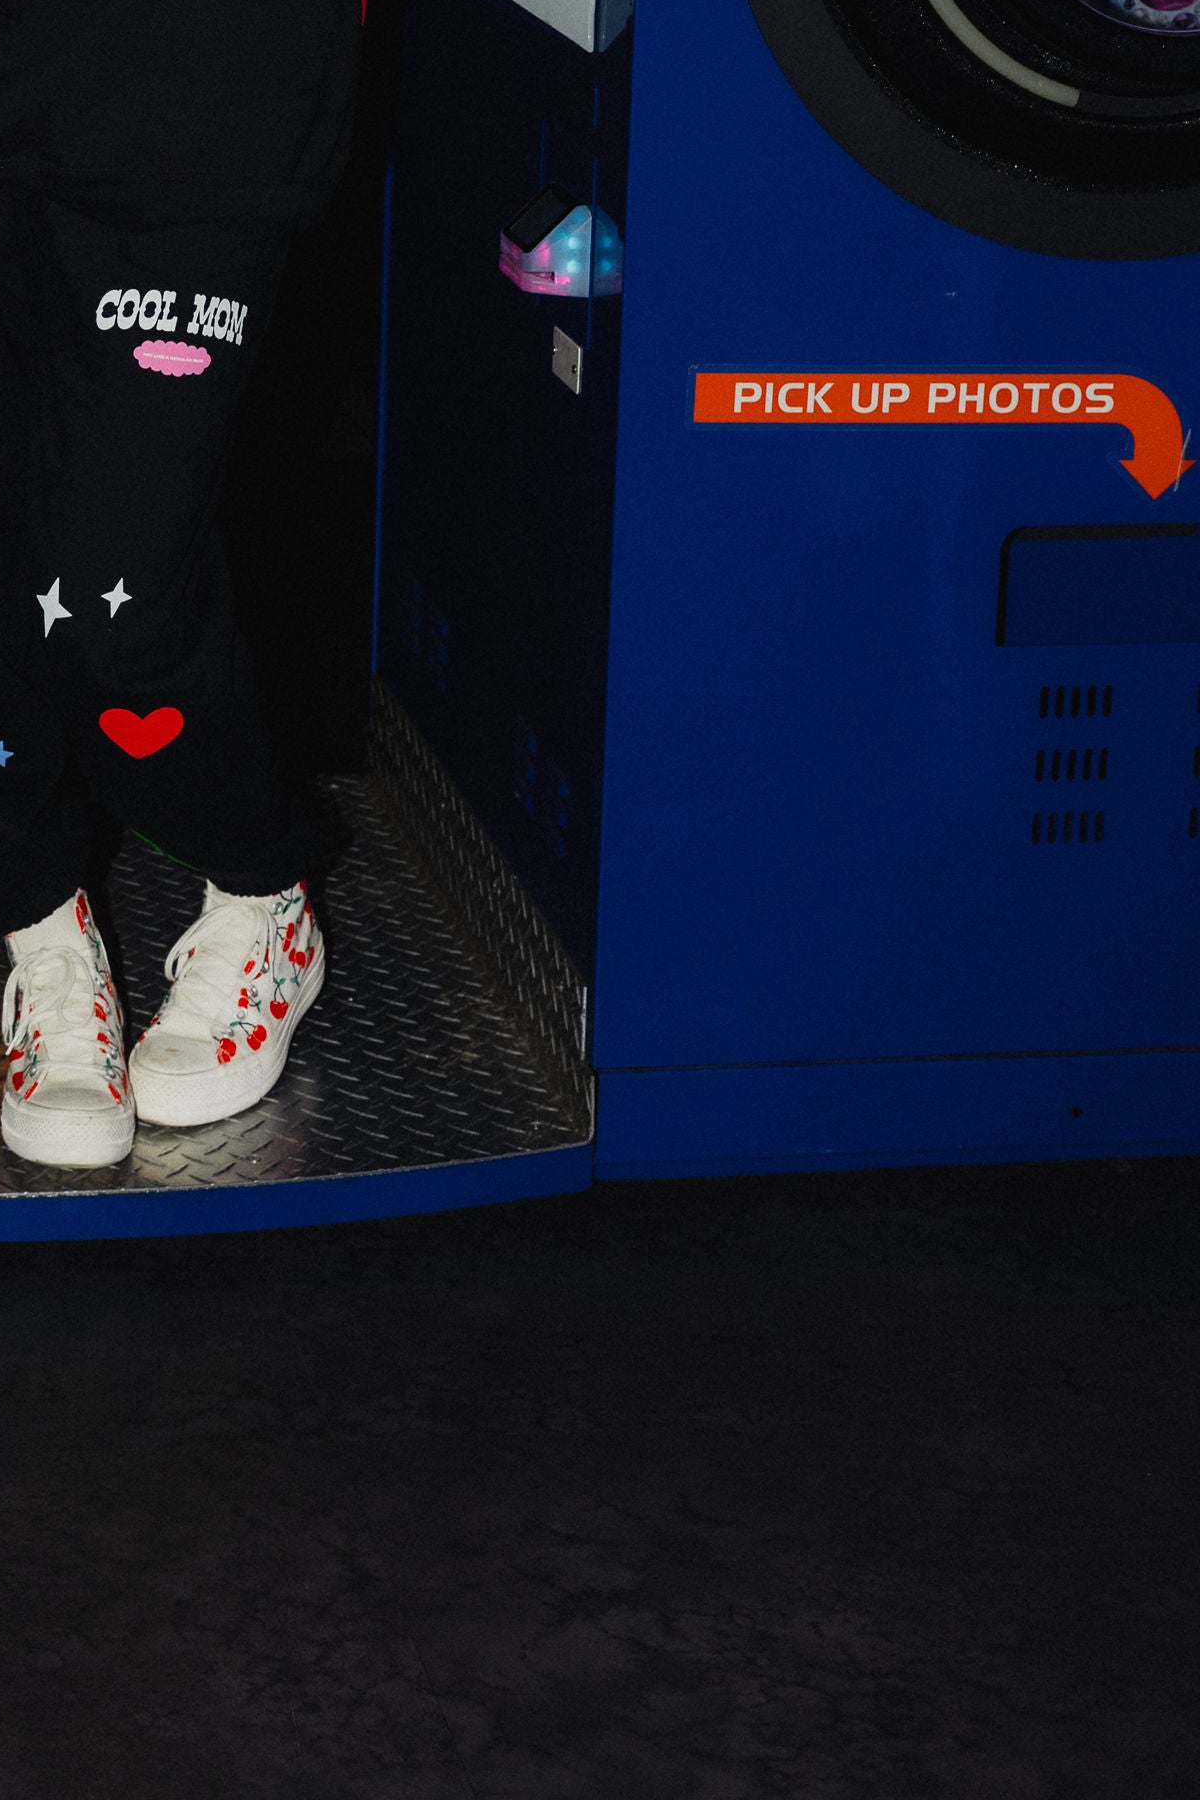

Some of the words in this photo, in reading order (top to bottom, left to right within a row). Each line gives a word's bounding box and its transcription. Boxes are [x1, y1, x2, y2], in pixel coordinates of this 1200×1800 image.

[95, 288, 178, 332] COOL
[186, 293, 249, 346] MOM
[733, 382, 834, 413] PICK
[851, 382, 910, 414] UP
[927, 382, 1114, 414] PHOTOS
